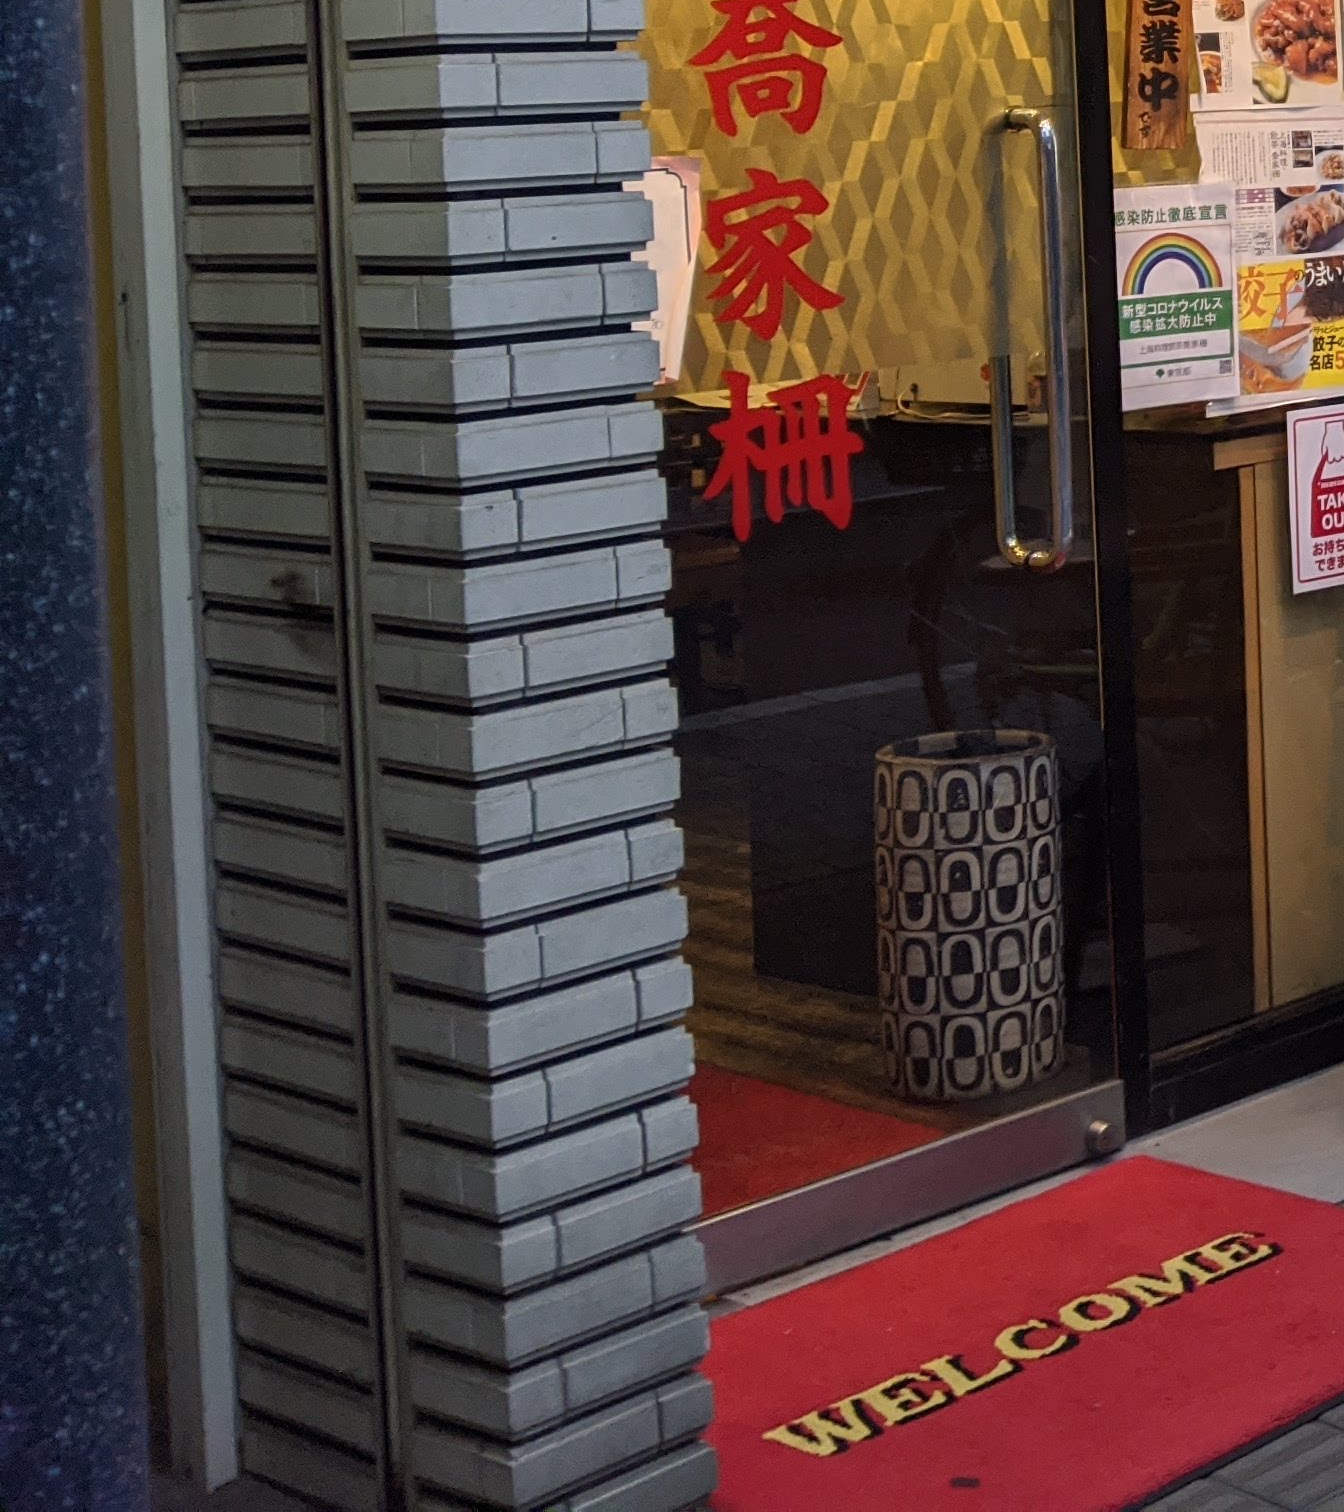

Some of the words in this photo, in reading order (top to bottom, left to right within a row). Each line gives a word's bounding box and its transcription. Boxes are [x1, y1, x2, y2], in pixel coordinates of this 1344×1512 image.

[1115, 204, 1228, 227] 感染防止徹底宣言
[1121, 296, 1224, 320] 新型コロナウイルス
[1129, 314, 1217, 335] 感染拡大防止中
[761, 1229, 1286, 1458] WELCOME
